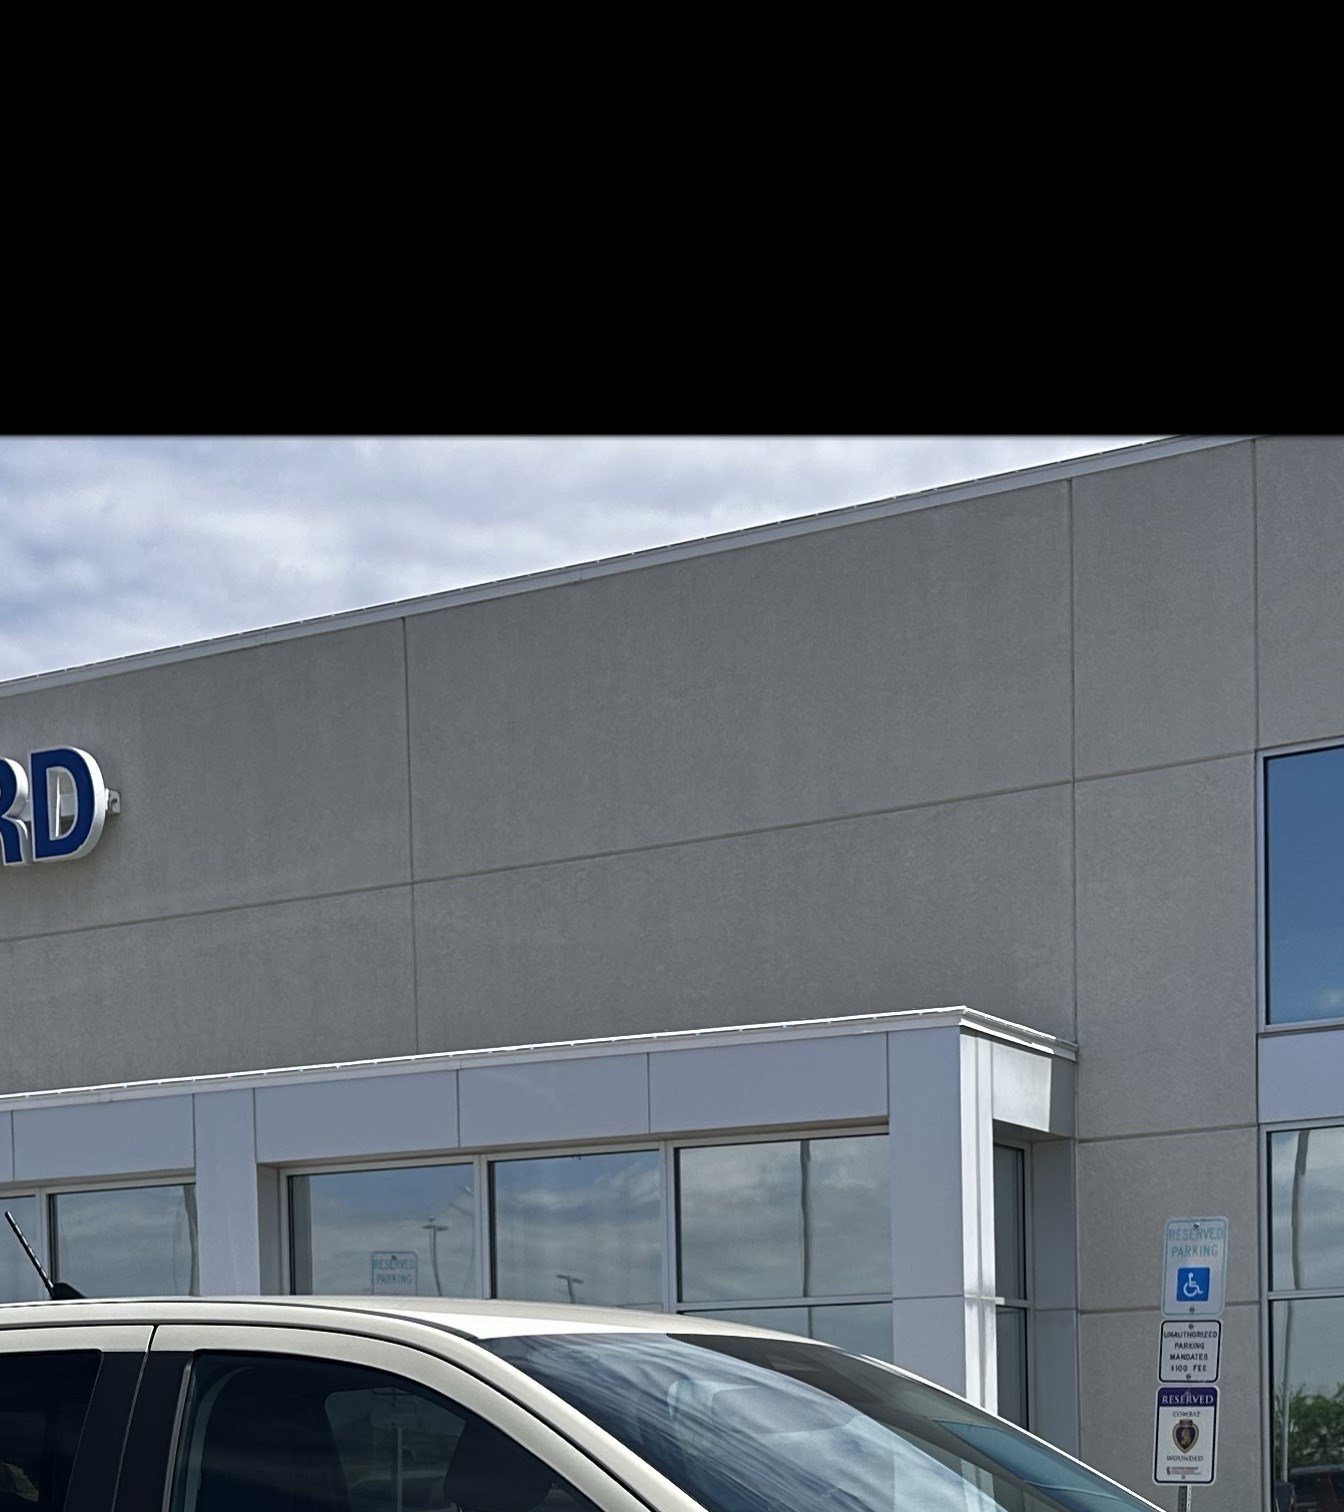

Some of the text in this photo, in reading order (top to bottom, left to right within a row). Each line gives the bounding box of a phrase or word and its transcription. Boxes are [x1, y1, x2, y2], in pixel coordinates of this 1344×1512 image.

[1167, 1227, 1224, 1242] RESERVED
[1170, 1245, 1219, 1259] PARKING
[1163, 1330, 1218, 1339] UNAUTHORIZED
[1174, 1342, 1205, 1350] PARKING
[1169, 1353, 1208, 1361] MANDATES
[1192, 1364, 1207, 1372] FEE
[1161, 1394, 1214, 1405] RESERVED
